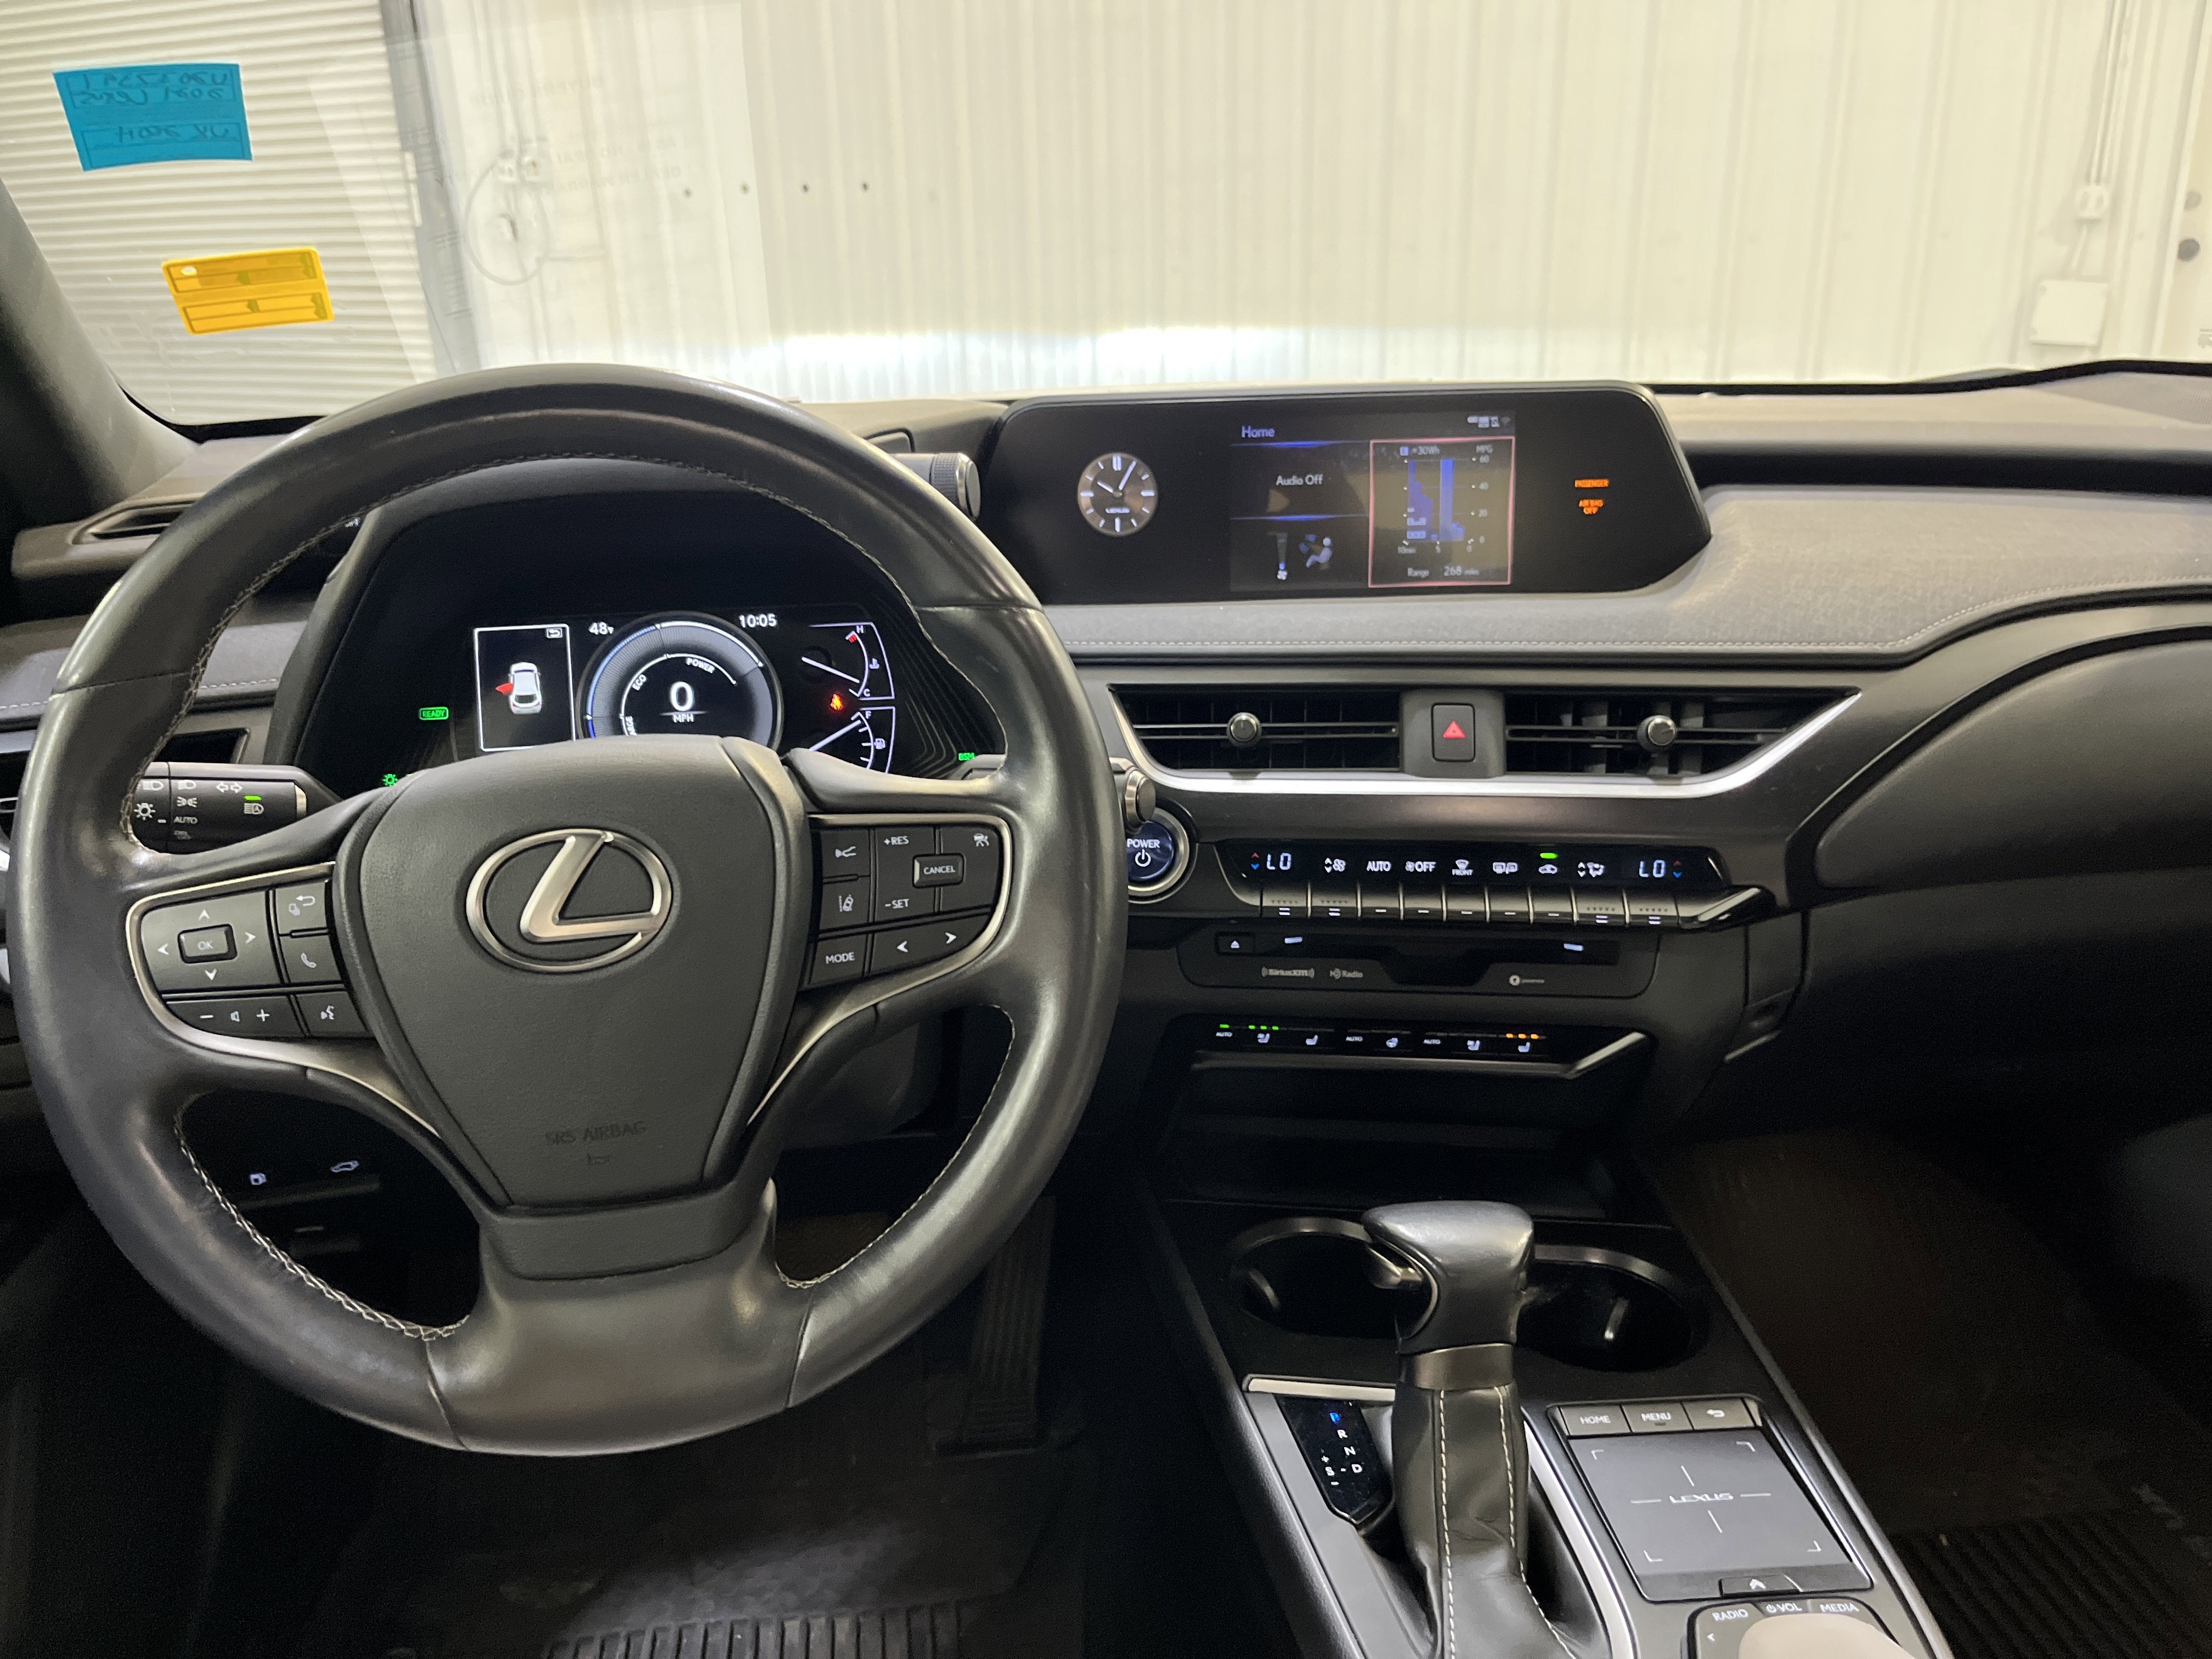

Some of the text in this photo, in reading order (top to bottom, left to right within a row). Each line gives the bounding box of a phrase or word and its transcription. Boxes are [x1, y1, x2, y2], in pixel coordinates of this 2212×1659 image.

[1242, 426, 1276, 438] Home
[1276, 474, 1323, 486] Audio Off
[1444, 566, 1462, 576] 268
[739, 613, 777, 628] 10:05
[857, 625, 864, 634] H
[686, 658, 715, 674] POWER
[631, 673, 648, 691] ECO
[670, 681, 695, 712] 0
[673, 714, 695, 723] MPH
[173, 816, 198, 824] AUTO
[1127, 838, 1160, 849] POWER
[1266, 853, 1291, 870] LO
[1367, 861, 1391, 872] AUTO
[1415, 861, 1436, 873] OFF
[923, 865, 956, 875] CANCEL
[1639, 859, 1666, 878] LO
[197, 940, 213, 951] OK
[825, 952, 855, 964] MODE
[1342, 970, 1363, 978] Radio
[1580, 1415, 1611, 1425] HOME
[1641, 1411, 1672, 1422] MENU
[1337, 1429, 1348, 1439] R
[1344, 1446, 1356, 1456] N
[1325, 1466, 1335, 1476] S
[1351, 1464, 1363, 1474] D
[1669, 1492, 1734, 1503] LEXUS
[1777, 1602, 1803, 1612] VOL
[1819, 1602, 1860, 1613] MEDIA
[1712, 1609, 1749, 1622] RADIO
